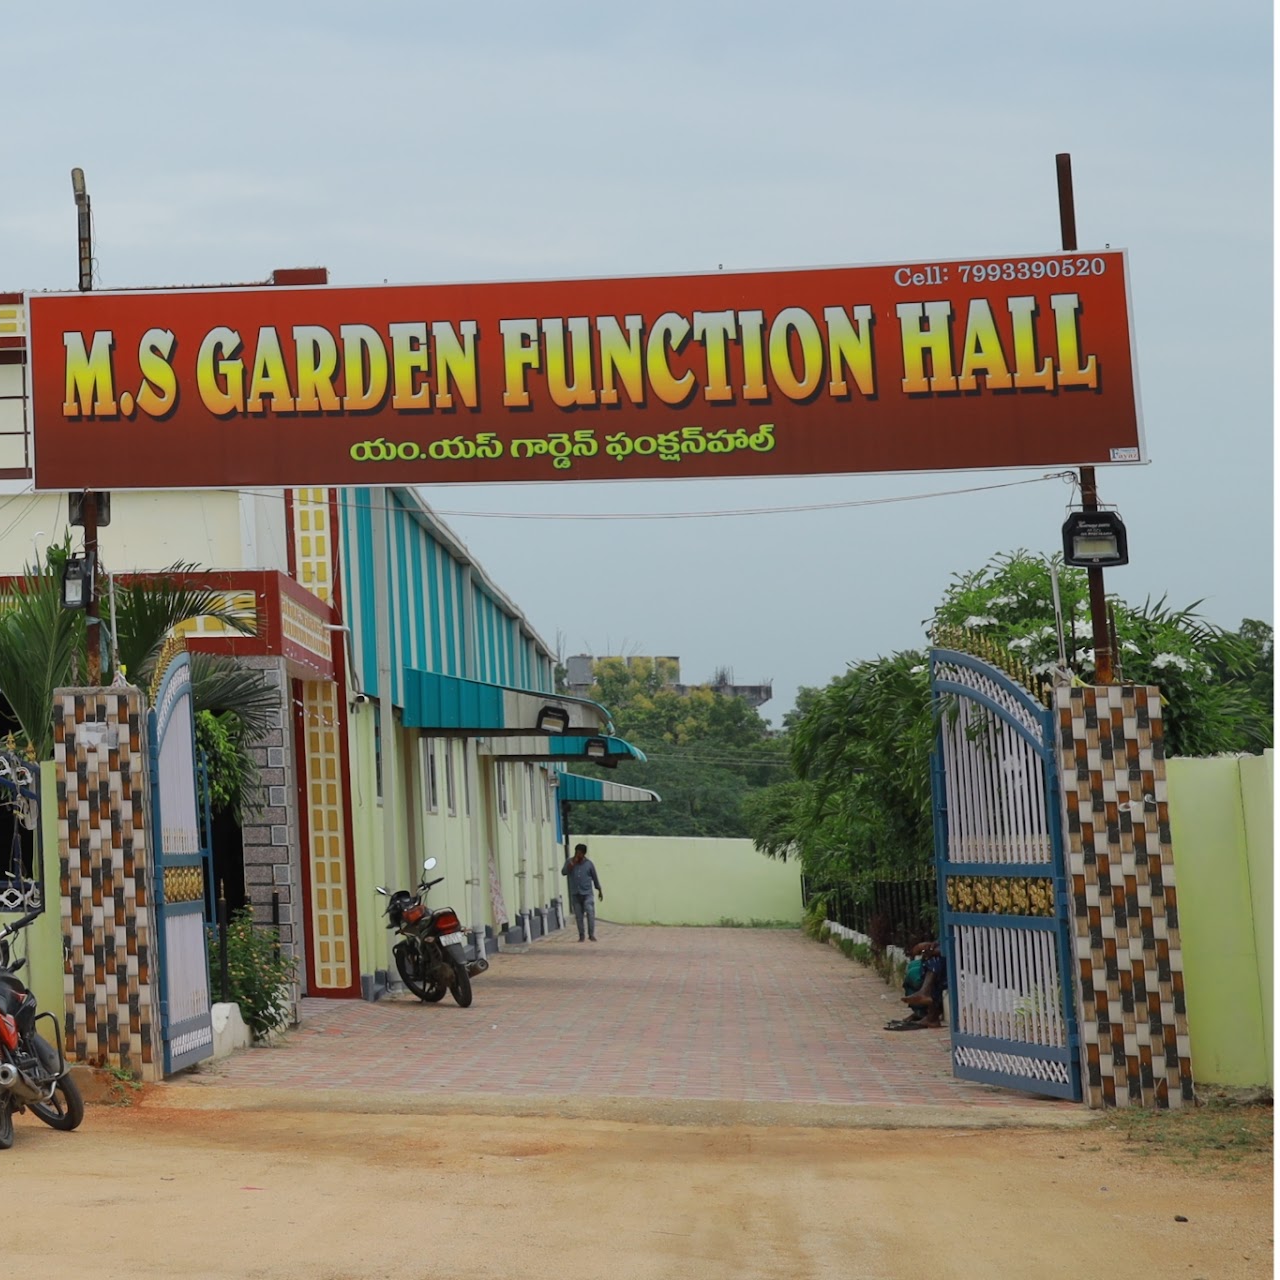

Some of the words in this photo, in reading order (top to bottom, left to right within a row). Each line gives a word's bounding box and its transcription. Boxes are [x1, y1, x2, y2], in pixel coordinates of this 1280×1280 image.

[894, 266, 950, 287] Cell:
[958, 257, 1106, 284] 7993390520
[62, 327, 177, 417] M.S
[196, 320, 479, 416] GARDEN
[498, 303, 875, 409] FUNCTION
[895, 292, 1098, 393] HALL
